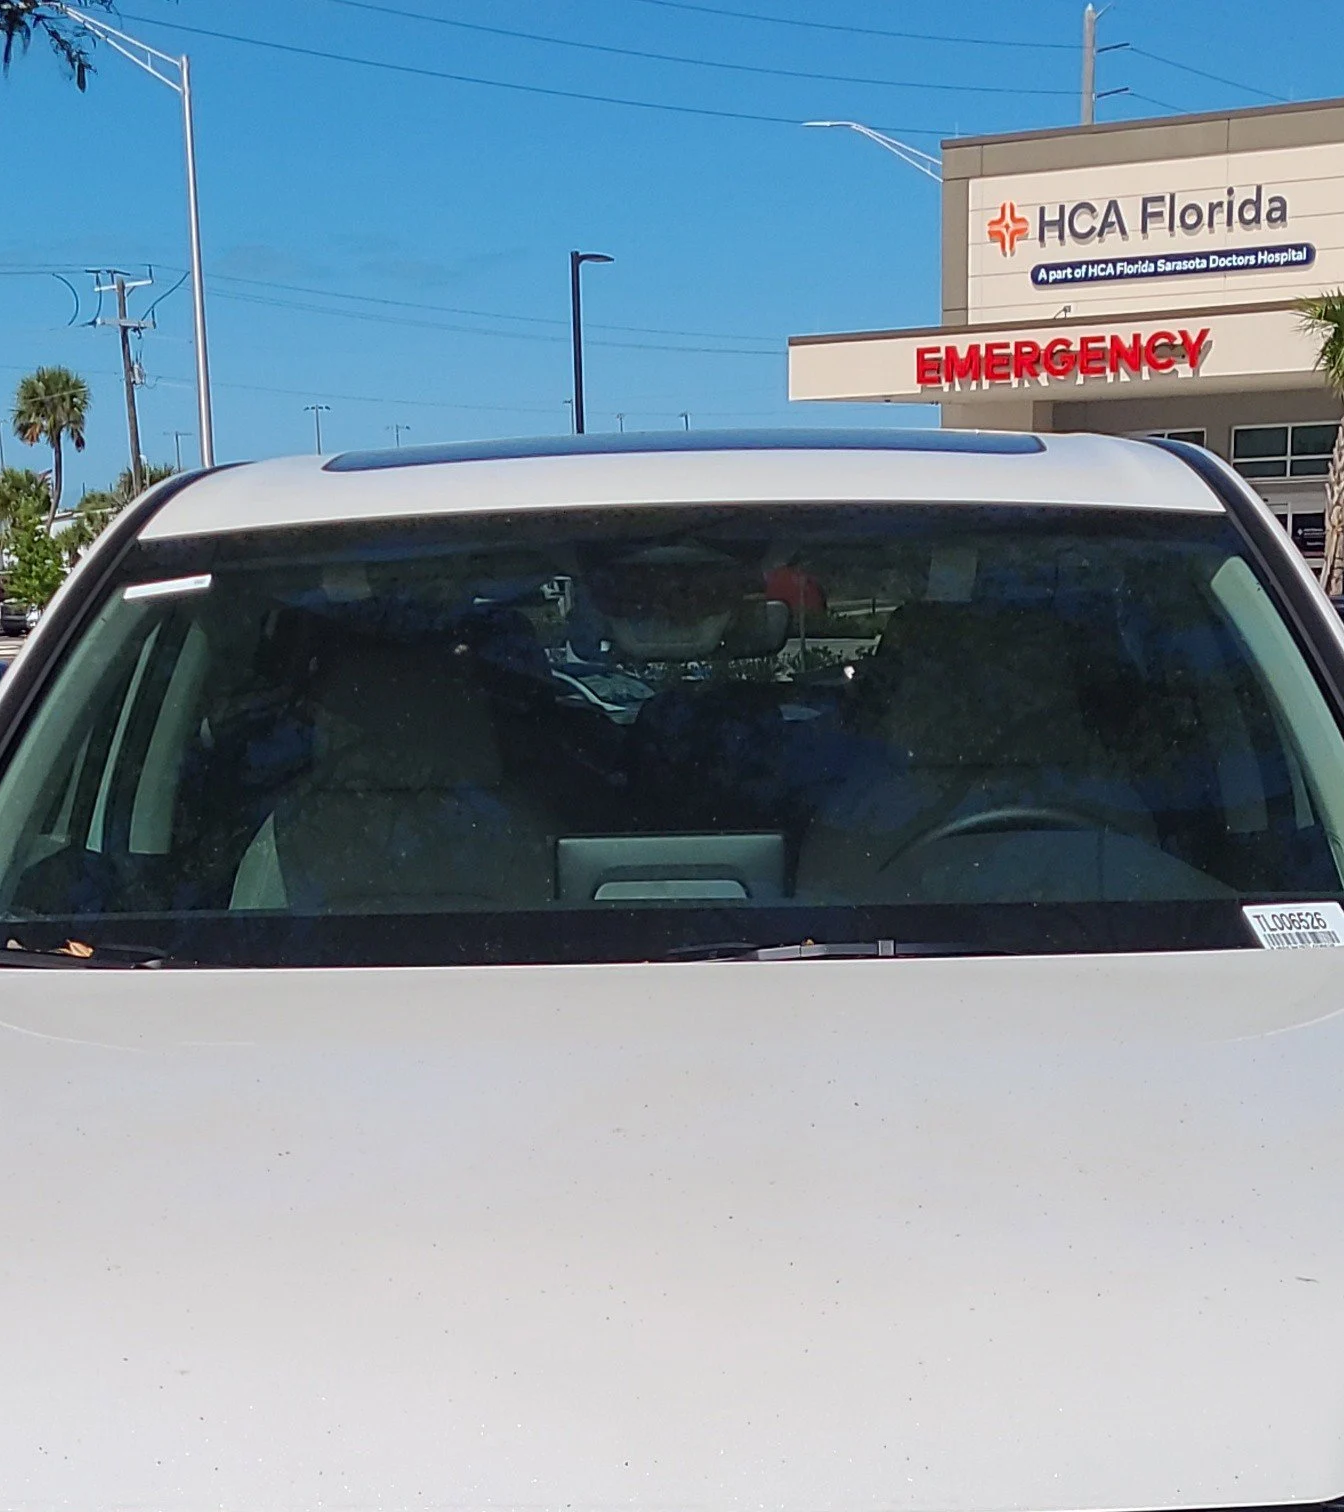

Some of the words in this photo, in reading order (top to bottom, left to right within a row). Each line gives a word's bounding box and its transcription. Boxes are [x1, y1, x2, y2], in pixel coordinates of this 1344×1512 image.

[1038, 199, 1129, 243] HCA
[1140, 184, 1288, 234] Florida
[1037, 267, 1048, 282] A
[1048, 268, 1073, 283] part
[1074, 264, 1088, 279] of
[1088, 263, 1115, 278] HCA
[1116, 260, 1155, 276] Florida
[1157, 257, 1207, 272] Sarasota
[1209, 253, 1256, 268] Doctors
[1257, 247, 1307, 265] Hospital
[915, 328, 1211, 387] EMERGENCY
[1253, 911, 1327, 932] TL006526
